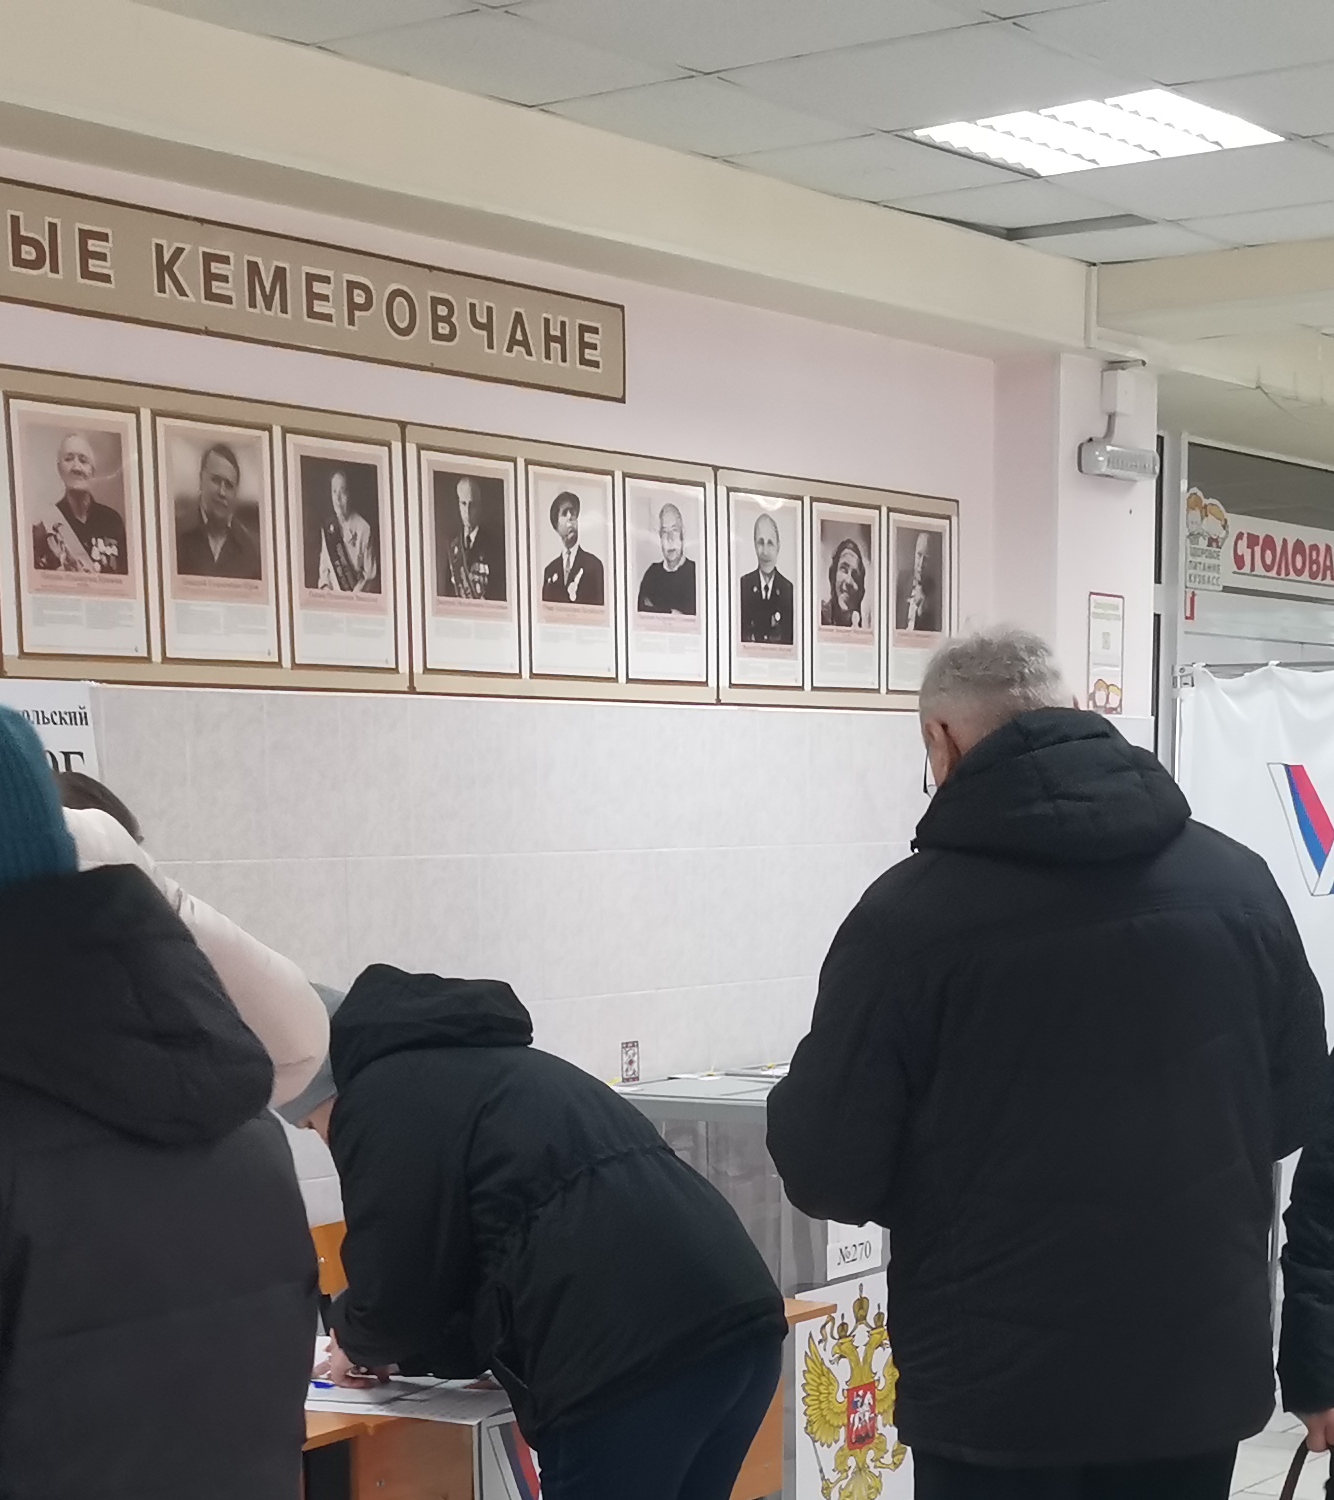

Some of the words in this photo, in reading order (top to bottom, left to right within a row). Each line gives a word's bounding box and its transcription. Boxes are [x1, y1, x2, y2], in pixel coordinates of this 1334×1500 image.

[152, 237, 603, 373] КЕМЕРОВЧАНЕ
[21, 705, 89, 727] ольский
[836, 1240, 872, 1266] №270
